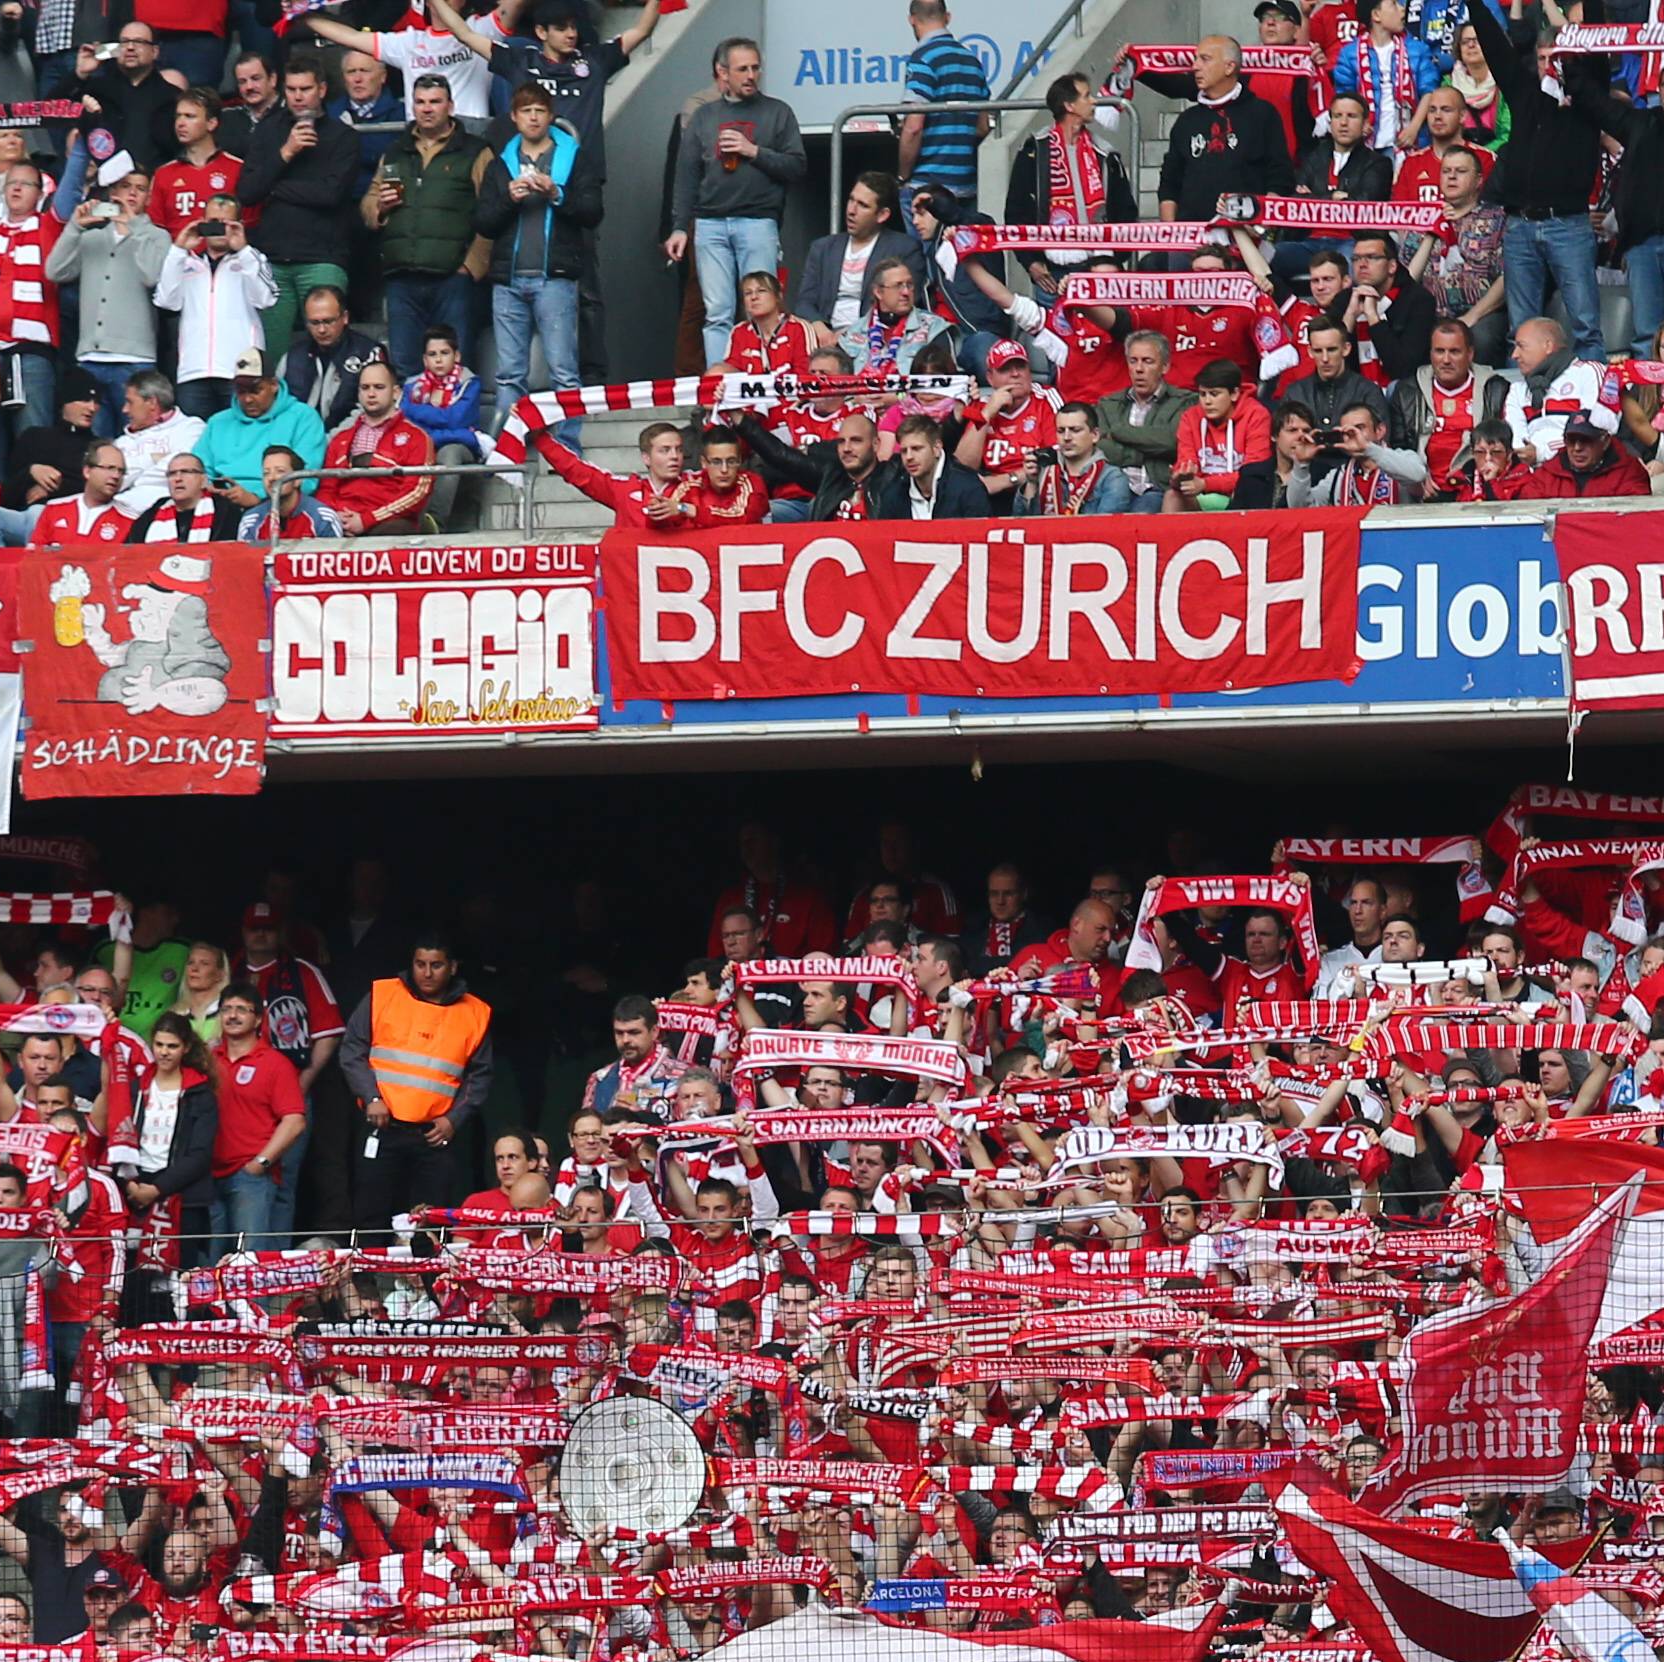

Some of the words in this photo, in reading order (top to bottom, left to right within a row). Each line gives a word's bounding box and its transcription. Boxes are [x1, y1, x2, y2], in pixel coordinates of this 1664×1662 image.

[1557, 24, 1627, 48] Bayern
[794, 45, 911, 88] Allian
[1265, 201, 1286, 218] FC
[1287, 200, 1352, 222] BAYERN
[1354, 201, 1442, 226] MÜNCHEN
[995, 226, 1022, 243] FC
[1028, 226, 1103, 243] BAYERN
[1111, 223, 1212, 242] MÜNCHEN
[1067, 277, 1091, 298] FC
[1096, 277, 1167, 299] BAYERN
[1174, 276, 1256, 302] MÜNCHEN
[287, 552, 393, 580] TORCIDA
[401, 549, 484, 578] JOVEM
[491, 548, 528, 575] DO
[534, 545, 586, 574] SUL
[637, 537, 868, 664] BFC
[885, 527, 1325, 664] ZÜRICH
[1356, 560, 1563, 661] Glob
[31, 729, 259, 780] SCHÄDLINGE
[1527, 841, 1584, 864] FINAL
[768, 957, 837, 977] BAYERN
[770, 1117, 848, 1136] BAYERN
[1002, 1250, 1055, 1277] MIA
[1070, 1249, 1131, 1275] SAN
[332, 1343, 426, 1360] FOREVER
[525, 1341, 568, 1360] ONE
[1069, 1397, 1130, 1426] SAN
[1142, 1395, 1205, 1418] MIA
[948, 1581, 971, 1599] FC
[230, 1631, 389, 1661] BAYERN
